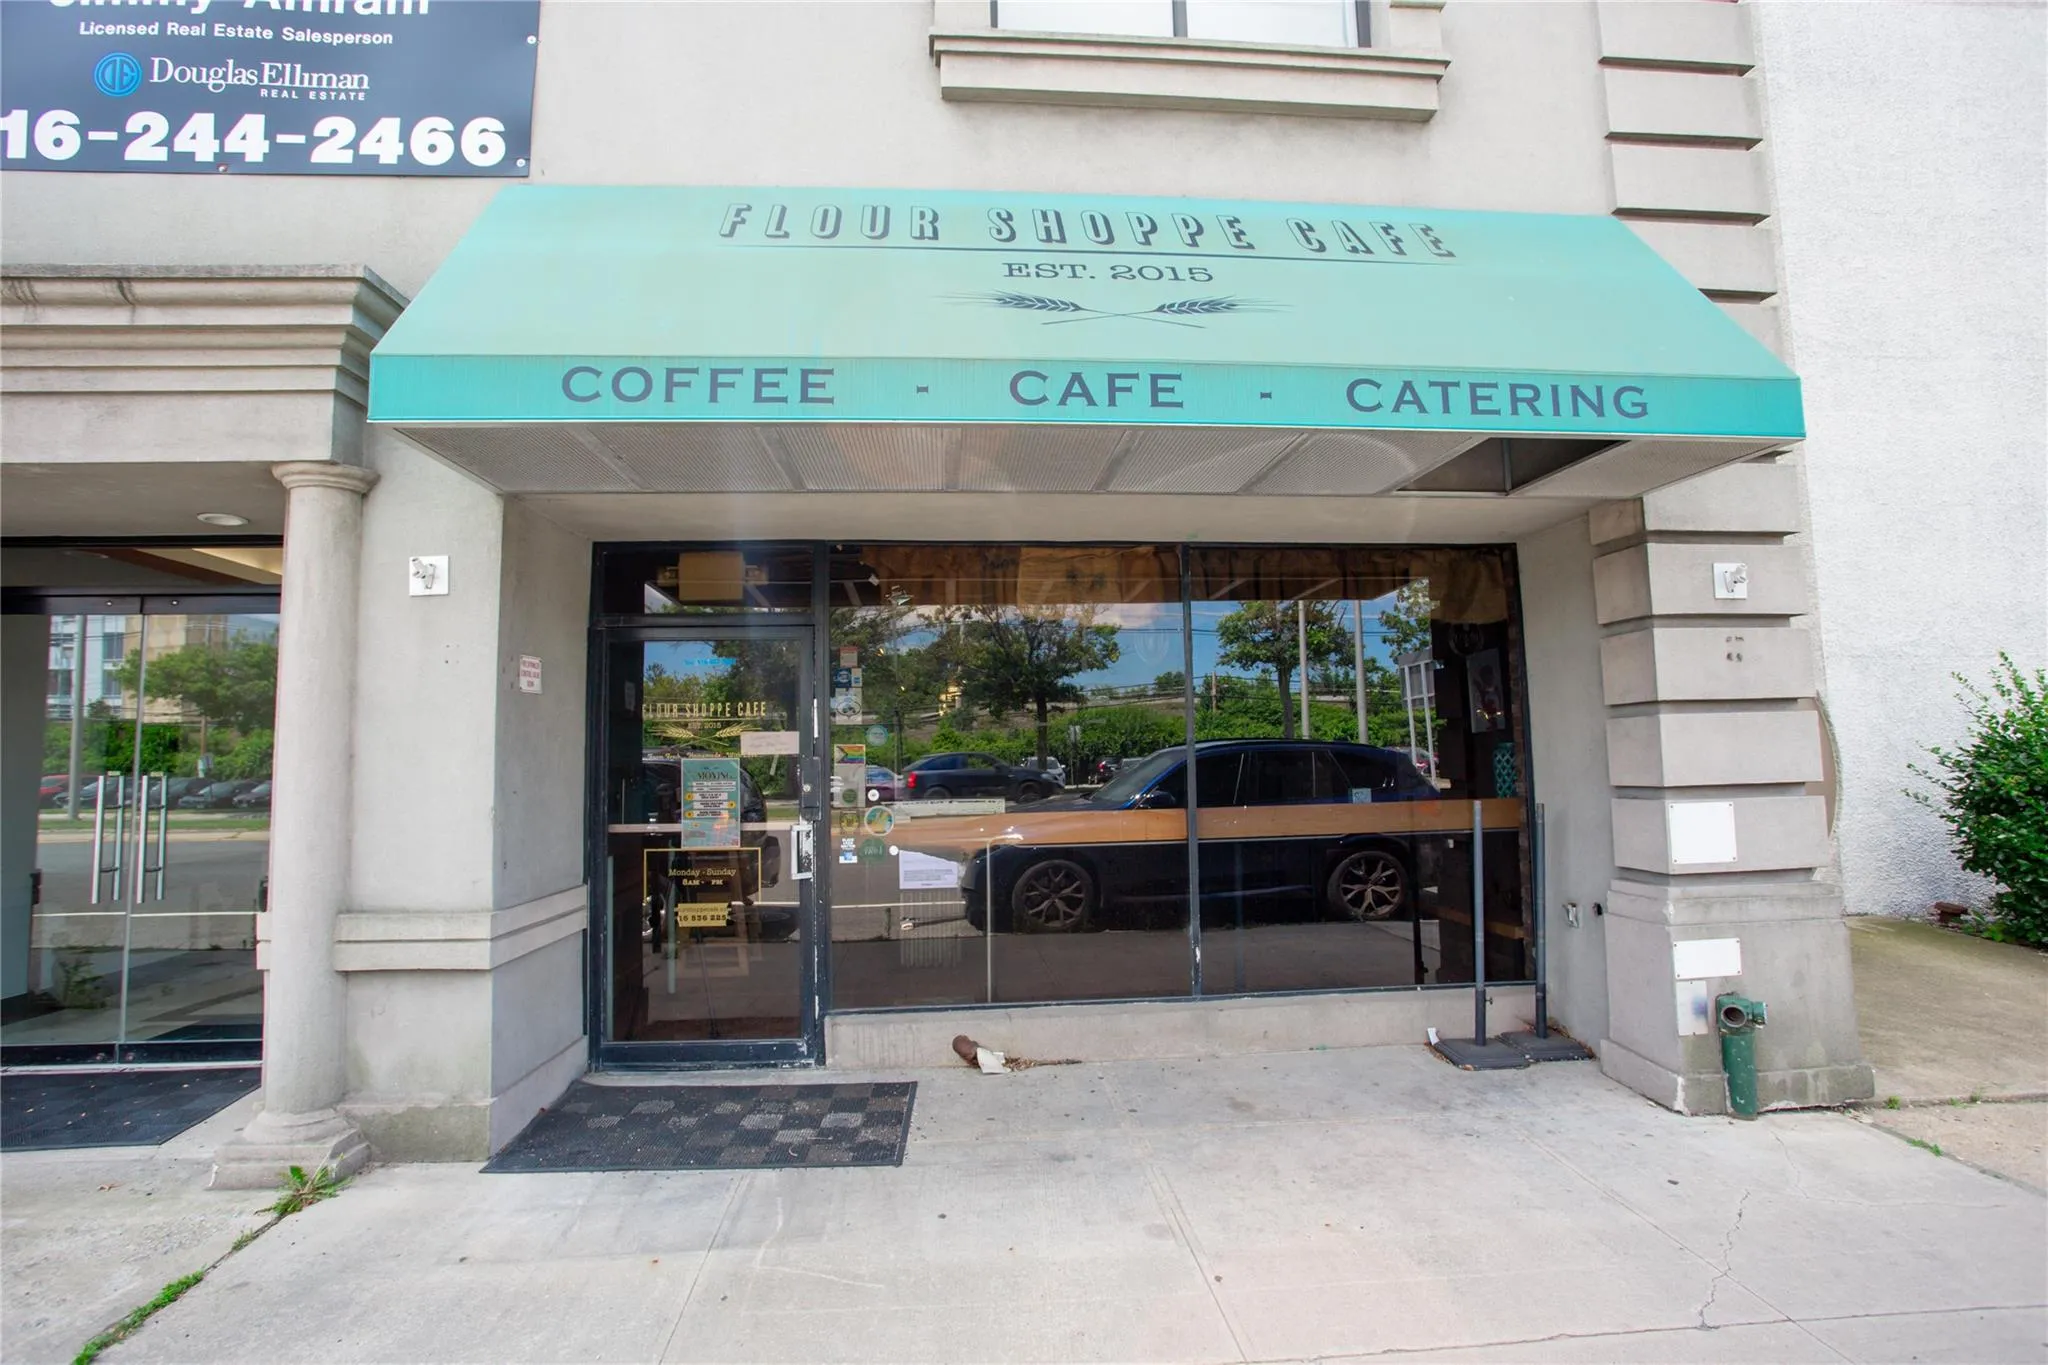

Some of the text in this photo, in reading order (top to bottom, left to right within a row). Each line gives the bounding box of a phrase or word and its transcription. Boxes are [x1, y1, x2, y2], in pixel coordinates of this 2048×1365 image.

[79, 21, 393, 46] Licensed Real Estate Salesperson
[149, 56, 370, 94] Douglas Elliman
[260, 88, 366, 101] REAL ESTATE
[719, 203, 1457, 258] FLOUR SHOPPE CAFE
[1002, 262, 1214, 283] EST. 2015
[562, 365, 835, 405] COFFEE
[1009, 370, 1184, 409] CAFE
[1346, 378, 1649, 419] CATERING
[685, 702, 731, 718] SHOPPE
[737, 701, 766, 717] CAFE
[668, 868, 700, 877] Monday
[706, 868, 737, 877] Sunday
